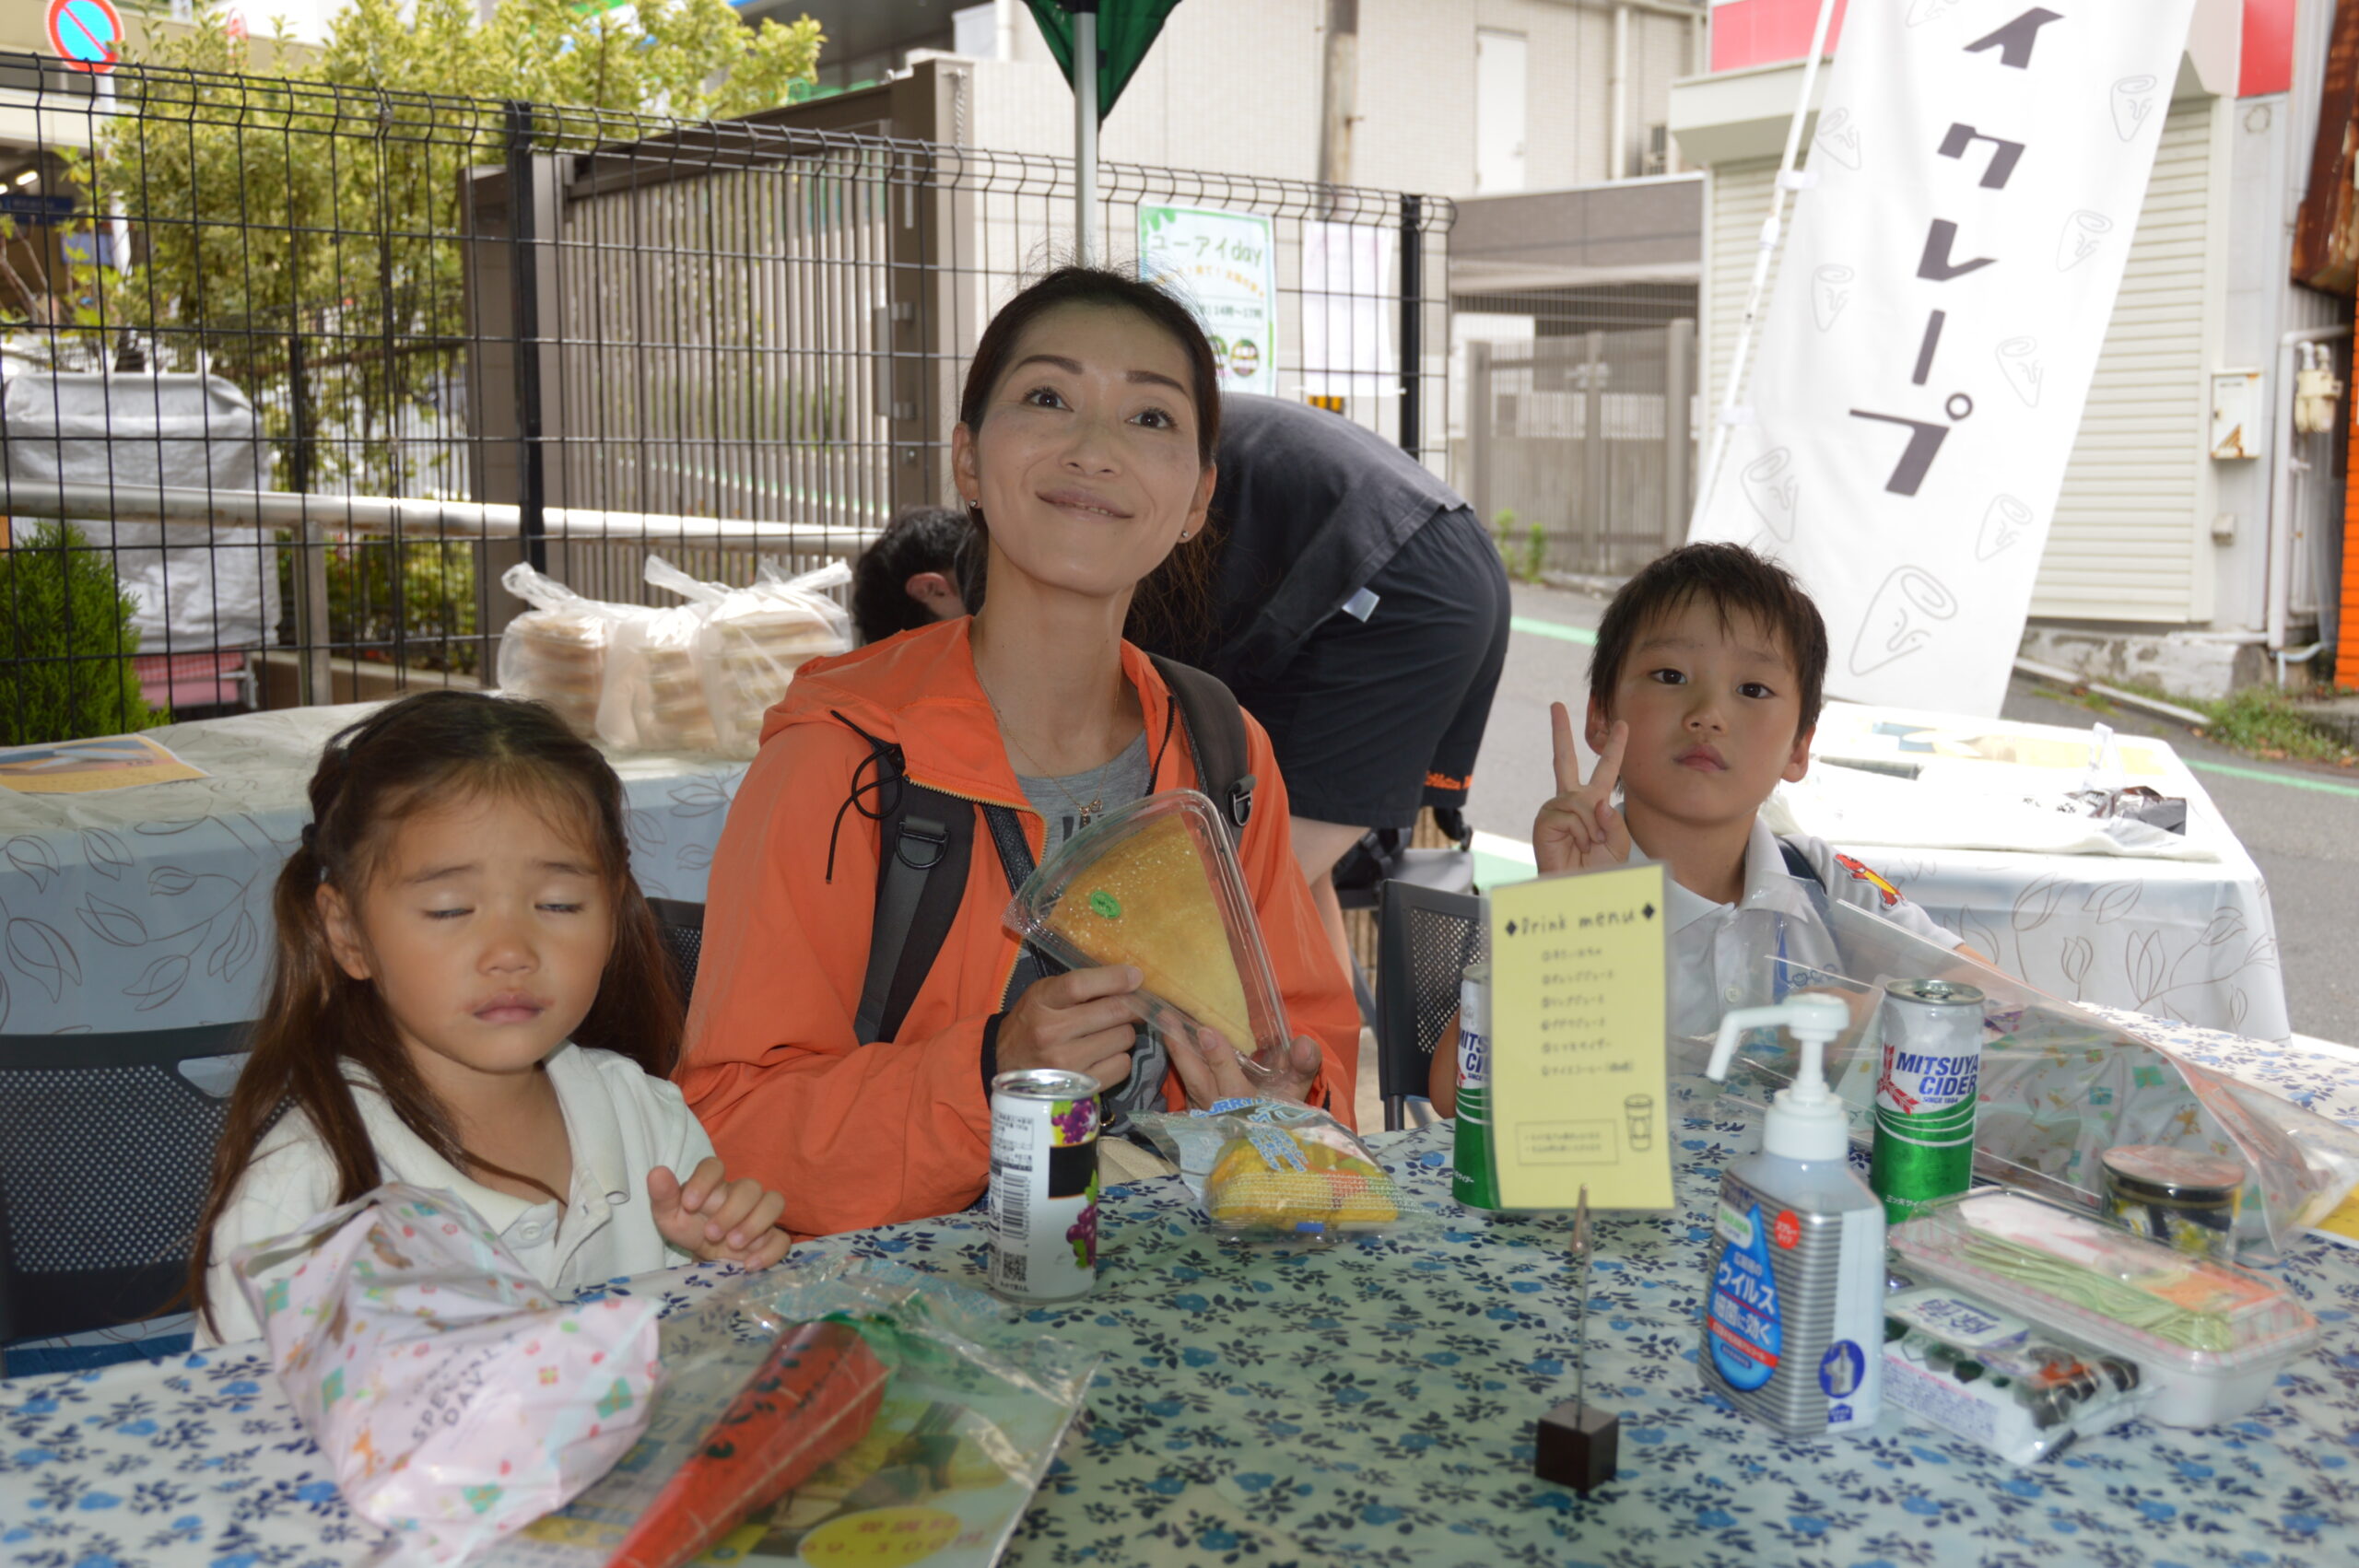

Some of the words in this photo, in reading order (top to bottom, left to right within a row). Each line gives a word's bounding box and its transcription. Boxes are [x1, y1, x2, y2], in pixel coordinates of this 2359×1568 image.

[1151, 233, 1262, 267] ユーアイday
[1522, 913, 1566, 935] Drink
[1579, 909, 1635, 928] menu
[1895, 1052, 1979, 1078] MITSUYA
[1918, 1073, 1978, 1096] CIDER
[1922, 1095, 1943, 1105] SINCE
[1718, 1259, 1777, 1316] ウイルス
